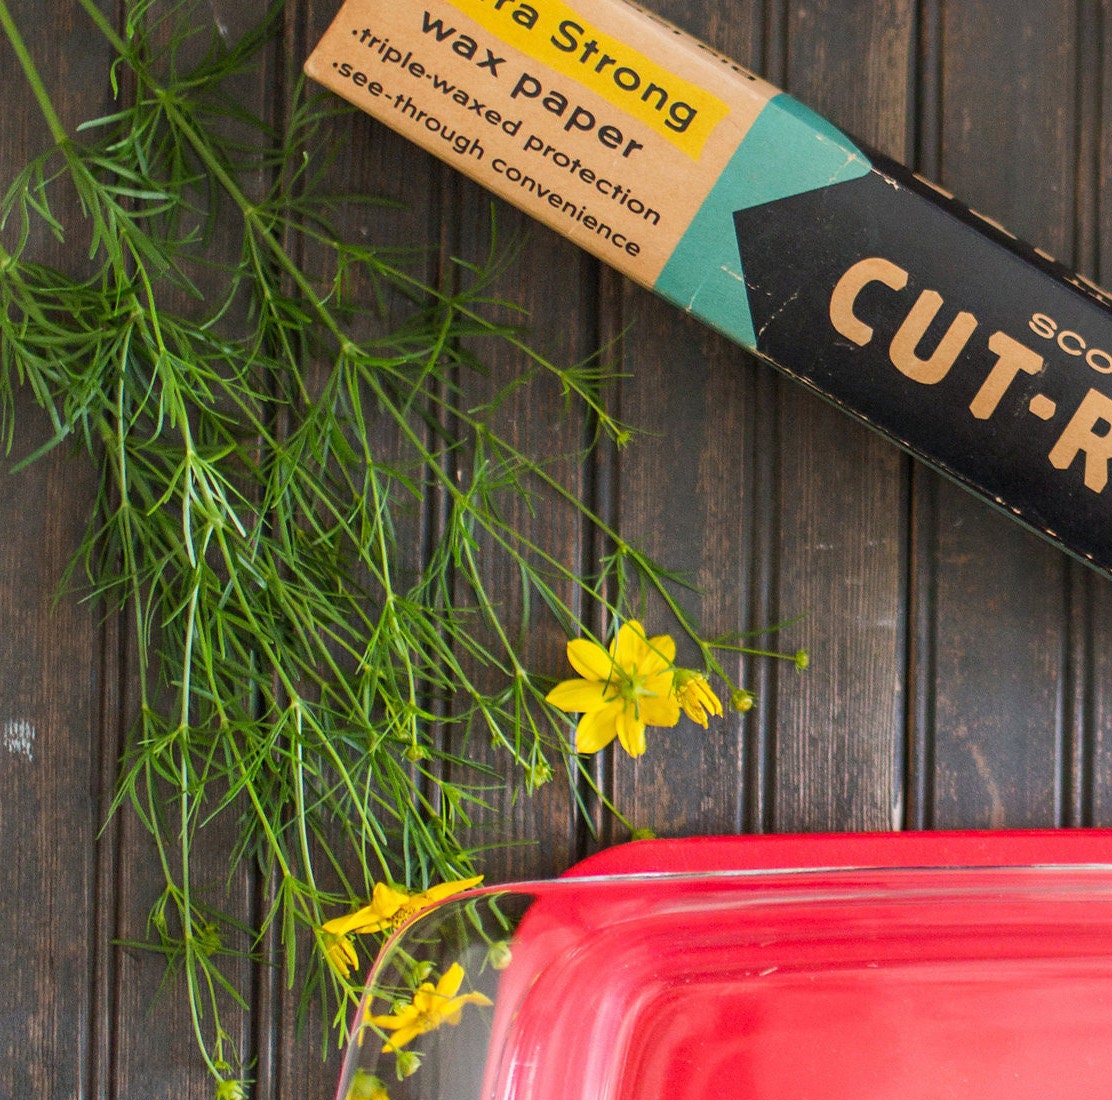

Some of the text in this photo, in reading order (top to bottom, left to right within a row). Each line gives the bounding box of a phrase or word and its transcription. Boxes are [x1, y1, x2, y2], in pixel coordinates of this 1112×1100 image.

[423, 12, 643, 158] wax paper
[551, 21, 697, 132] Strong
[491, 158, 640, 257] convenience
[524, 134, 661, 226] protection
